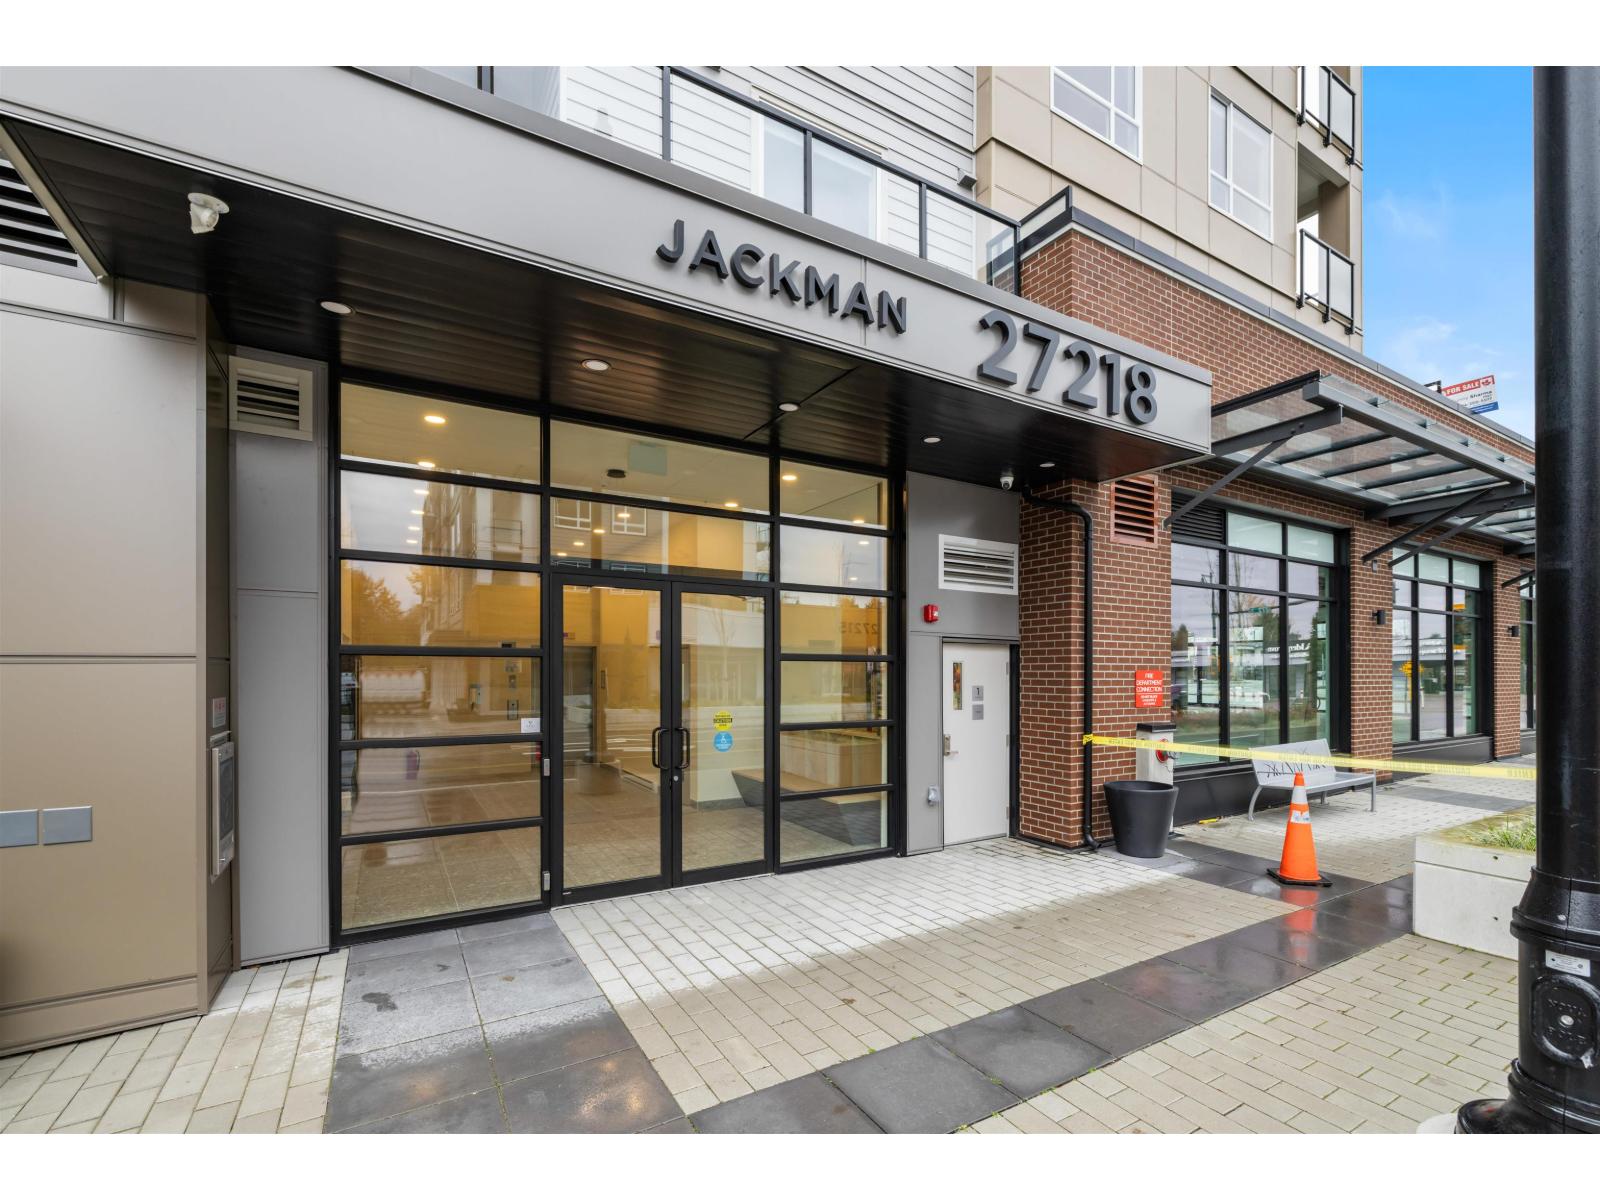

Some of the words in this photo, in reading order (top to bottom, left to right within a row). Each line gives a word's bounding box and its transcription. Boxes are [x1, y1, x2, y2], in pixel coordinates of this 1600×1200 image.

[656, 218, 906, 334] JACKMAN
[977, 310, 1158, 425] 27218
[1445, 387, 1461, 396] FOR
[1462, 381, 1480, 390] SALE
